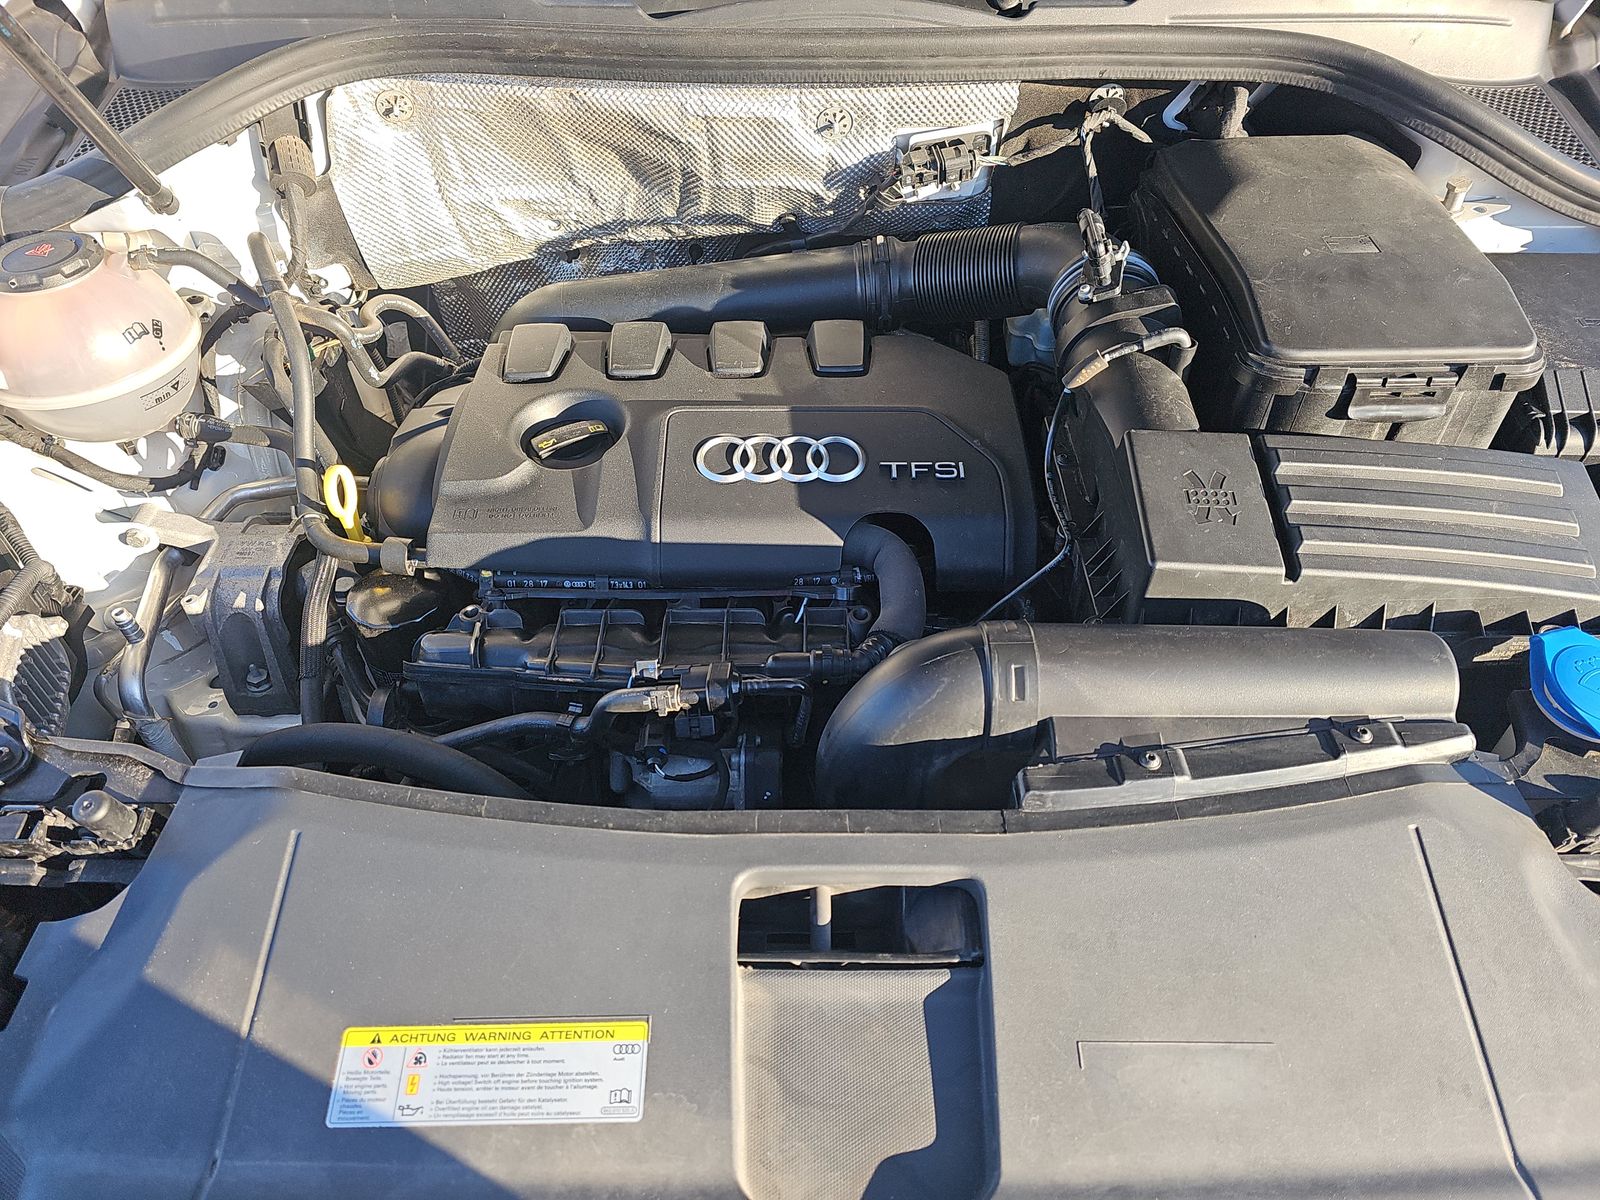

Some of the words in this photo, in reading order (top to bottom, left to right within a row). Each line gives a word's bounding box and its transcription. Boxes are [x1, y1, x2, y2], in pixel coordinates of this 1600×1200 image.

[155, 391, 171, 404] min
[880, 461, 965, 480] TFSI
[507, 580, 516, 588] 01
[524, 580, 534, 588] 28
[540, 580, 548, 588] 17
[637, 581, 647, 589] 01
[794, 577, 804, 586] 28
[813, 577, 821, 585] 17
[389, 1032, 456, 1043] ACHTUNG
[465, 1030, 532, 1041] WARNING
[540, 1028, 616, 1040] ATTENTION
